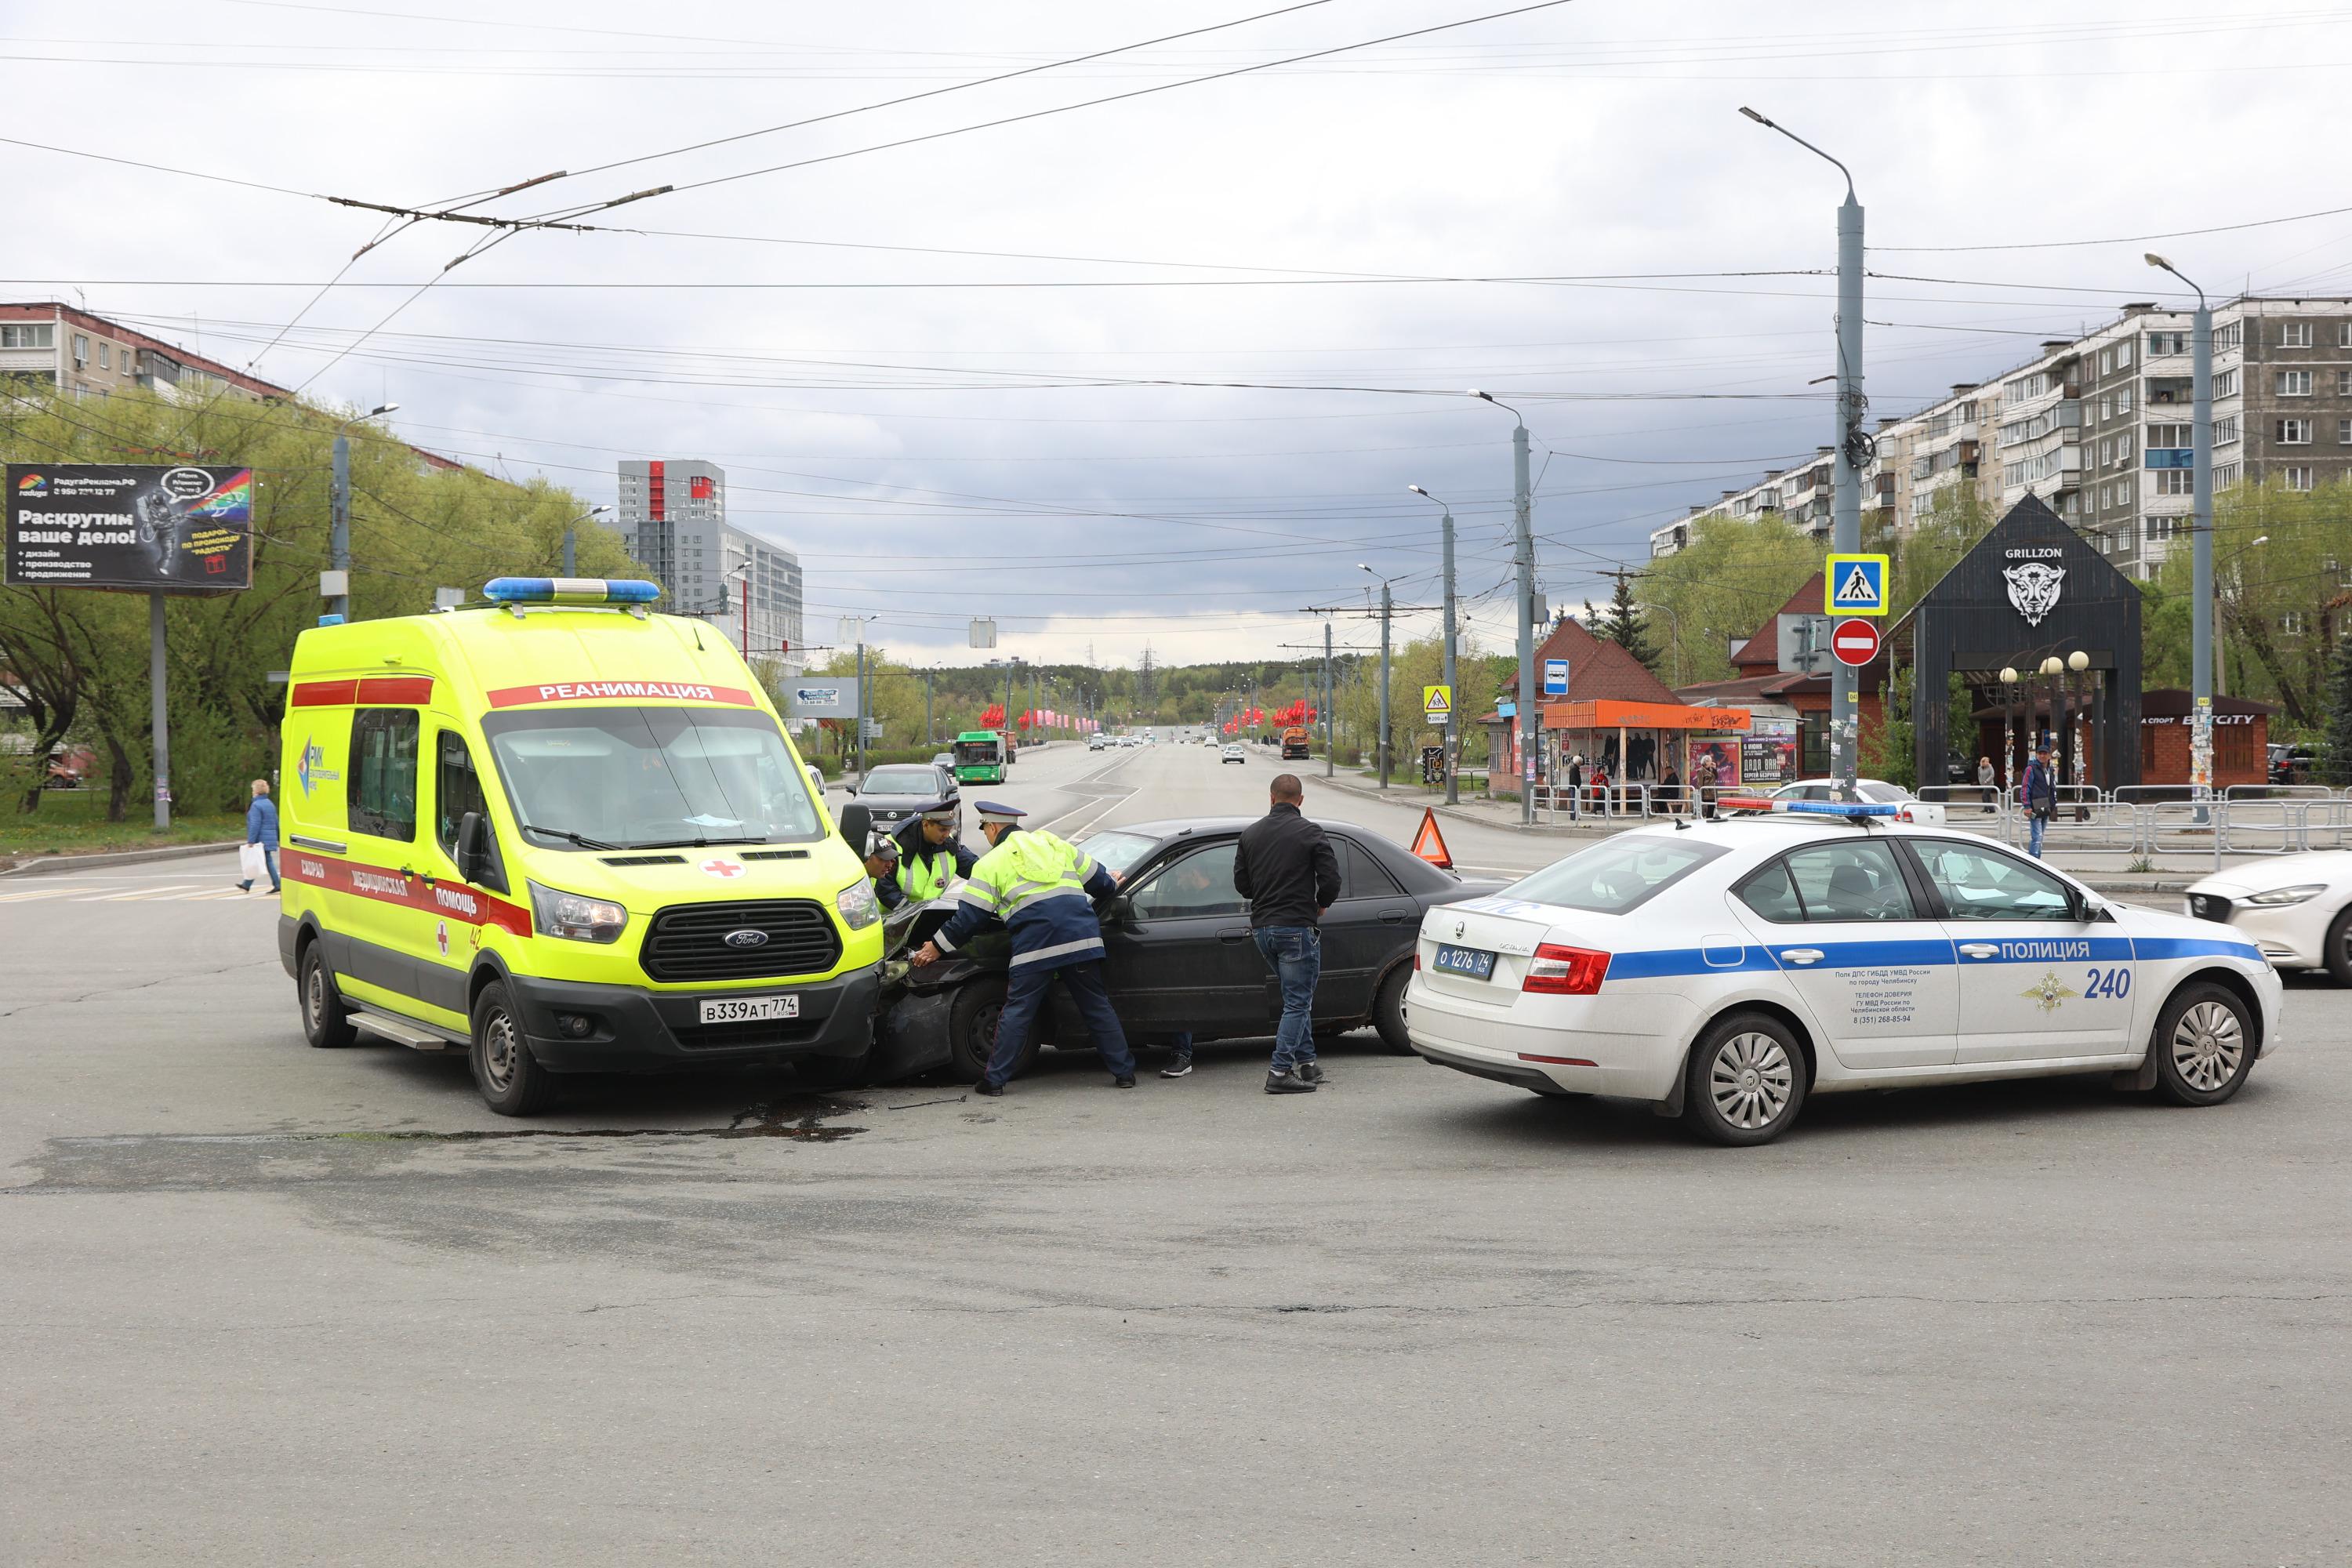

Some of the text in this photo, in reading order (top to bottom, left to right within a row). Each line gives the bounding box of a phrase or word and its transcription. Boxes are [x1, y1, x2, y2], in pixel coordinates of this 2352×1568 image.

[19, 510, 134, 528] Раскрутим
[19, 530, 136, 545] ваше дело!
[2005, 548, 2062, 558] GRILLZON
[539, 683, 714, 699] РЕАНИМАЦИЯ
[300, 859, 325, 879] СКОРАЯ
[351, 869, 408, 897] МЕДИЦИНСКАЯ
[436, 887, 477, 916] ПОМОЩЬ
[735, 933, 760, 945] Ford
[1499, 942, 1530, 953] OCTAVIA
[1451, 949, 1473, 969] 1276
[1478, 953, 1490, 968] 74
[2002, 942, 2090, 960] ПОЛИЦИЯ
[2085, 968, 2130, 999] 240
[706, 998, 795, 1020] В339АТ 774
[1860, 1016, 1876, 1025] (351)
